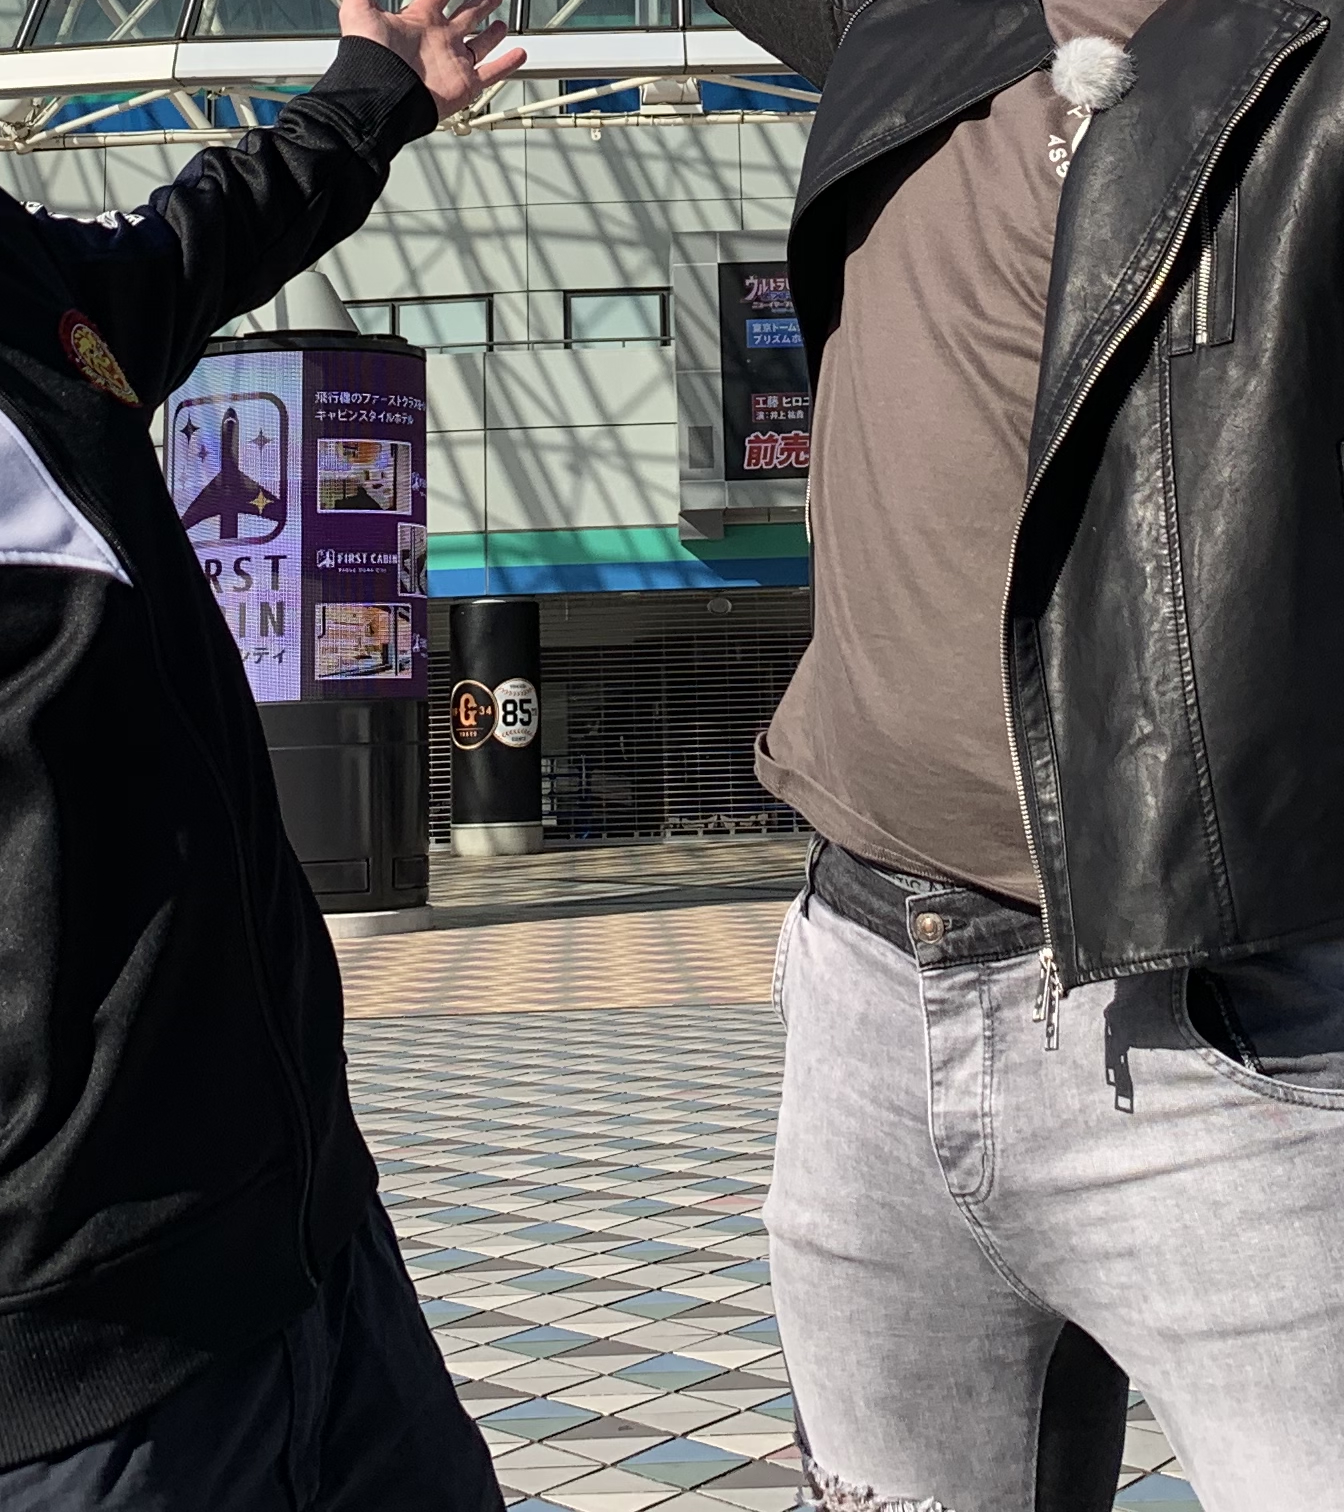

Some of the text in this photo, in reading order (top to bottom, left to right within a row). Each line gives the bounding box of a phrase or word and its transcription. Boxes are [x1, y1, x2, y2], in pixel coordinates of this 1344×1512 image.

[741, 275, 791, 303] ウルトラ
[743, 431, 810, 470] 前売
[337, 552, 367, 564] FIRST
[502, 698, 532, 727] 85
